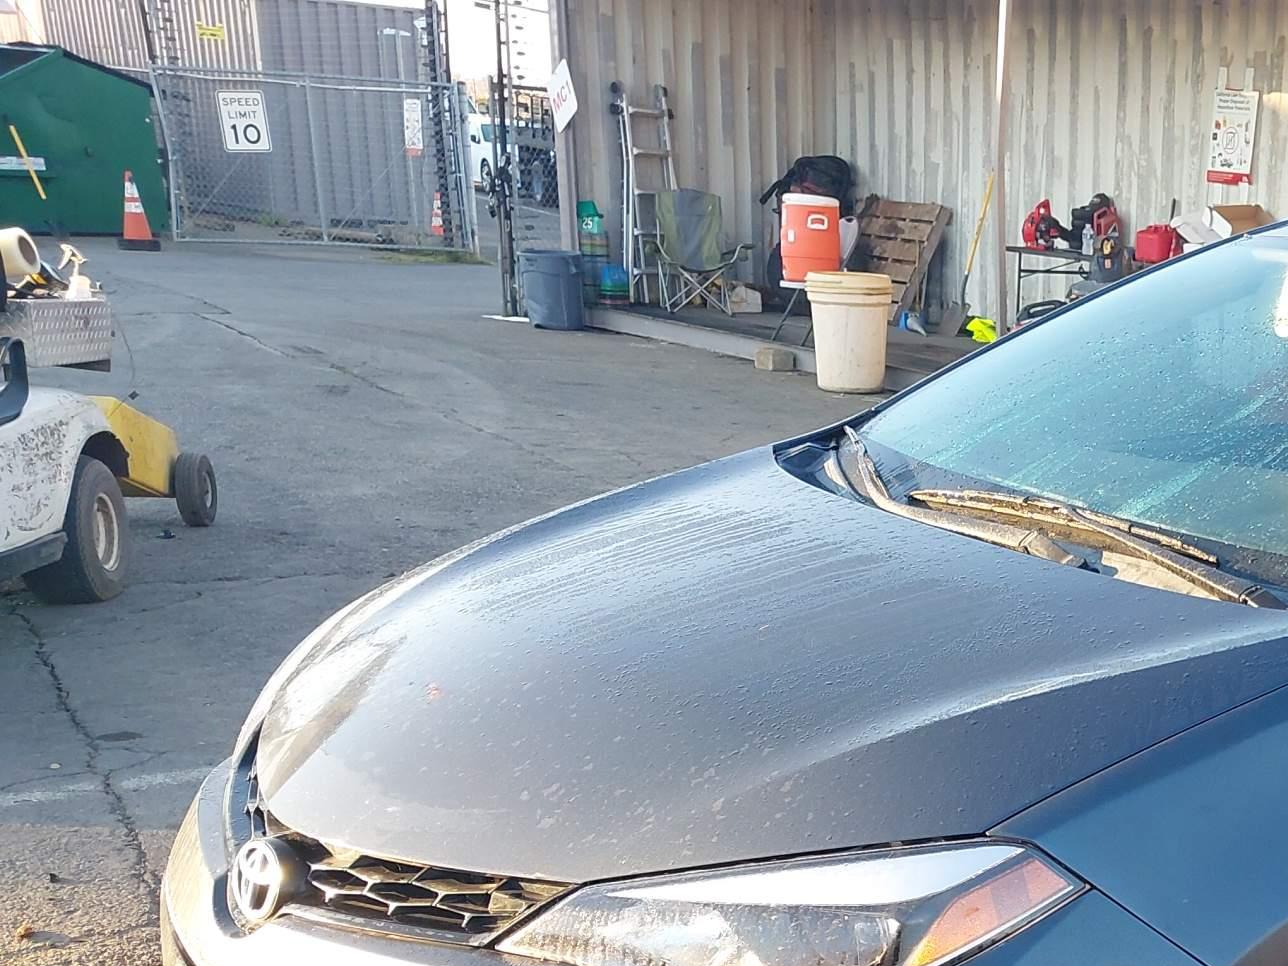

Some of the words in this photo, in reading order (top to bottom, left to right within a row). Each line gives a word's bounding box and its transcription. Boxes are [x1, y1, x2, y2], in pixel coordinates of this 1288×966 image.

[221, 97, 260, 107] SPEED
[551, 79, 571, 114] MC1
[227, 110, 258, 120] LIMIT
[230, 123, 262, 145] 10
